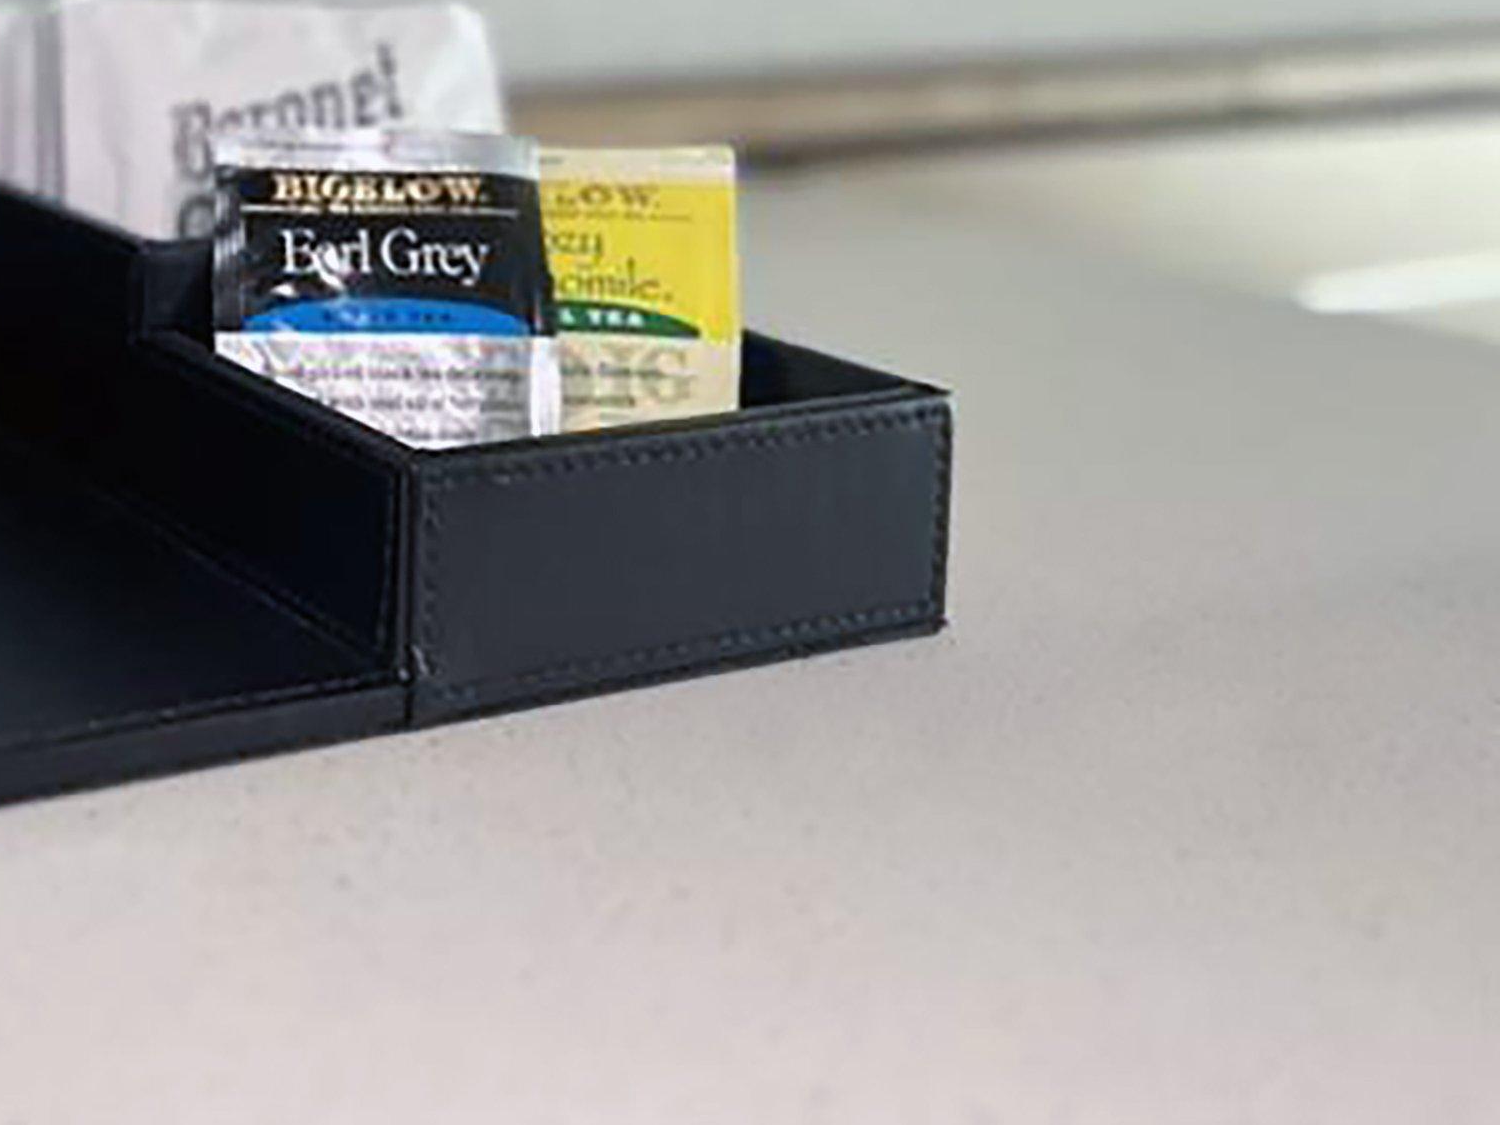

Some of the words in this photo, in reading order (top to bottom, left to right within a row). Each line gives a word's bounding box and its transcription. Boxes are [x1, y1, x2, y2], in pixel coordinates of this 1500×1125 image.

[272, 174, 480, 203] BIGELOW
[281, 227, 372, 276] Earl
[380, 227, 491, 286] Grey
